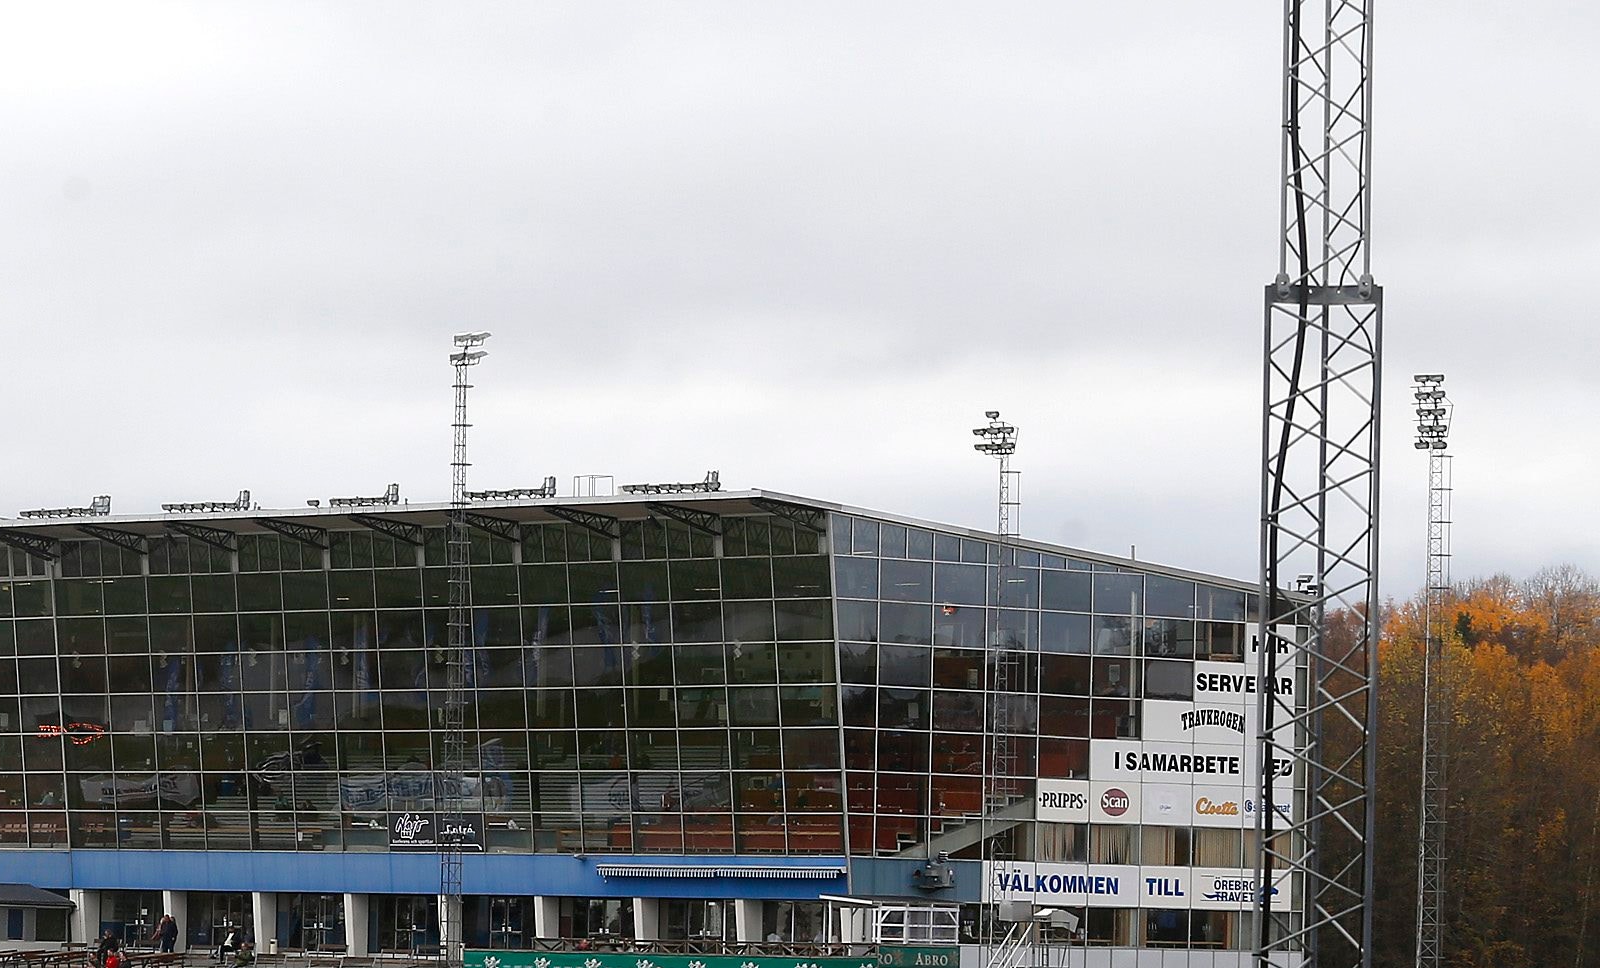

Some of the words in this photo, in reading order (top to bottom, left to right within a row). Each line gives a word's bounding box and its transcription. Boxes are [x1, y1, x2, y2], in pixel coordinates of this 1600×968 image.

[1252, 635, 1289, 654] HR
[1196, 673, 1293, 695] SERVEAR
[1114, 751, 1120, 770] I
[1125, 752, 1240, 775] SAMARBETE
[1262, 758, 1293, 777] ED
[1102, 793, 1128, 808] Scan
[1195, 797, 1240, 816] Cloetta
[998, 869, 1119, 895] VÄLKOMMEN
[1145, 878, 1185, 897] TILL
